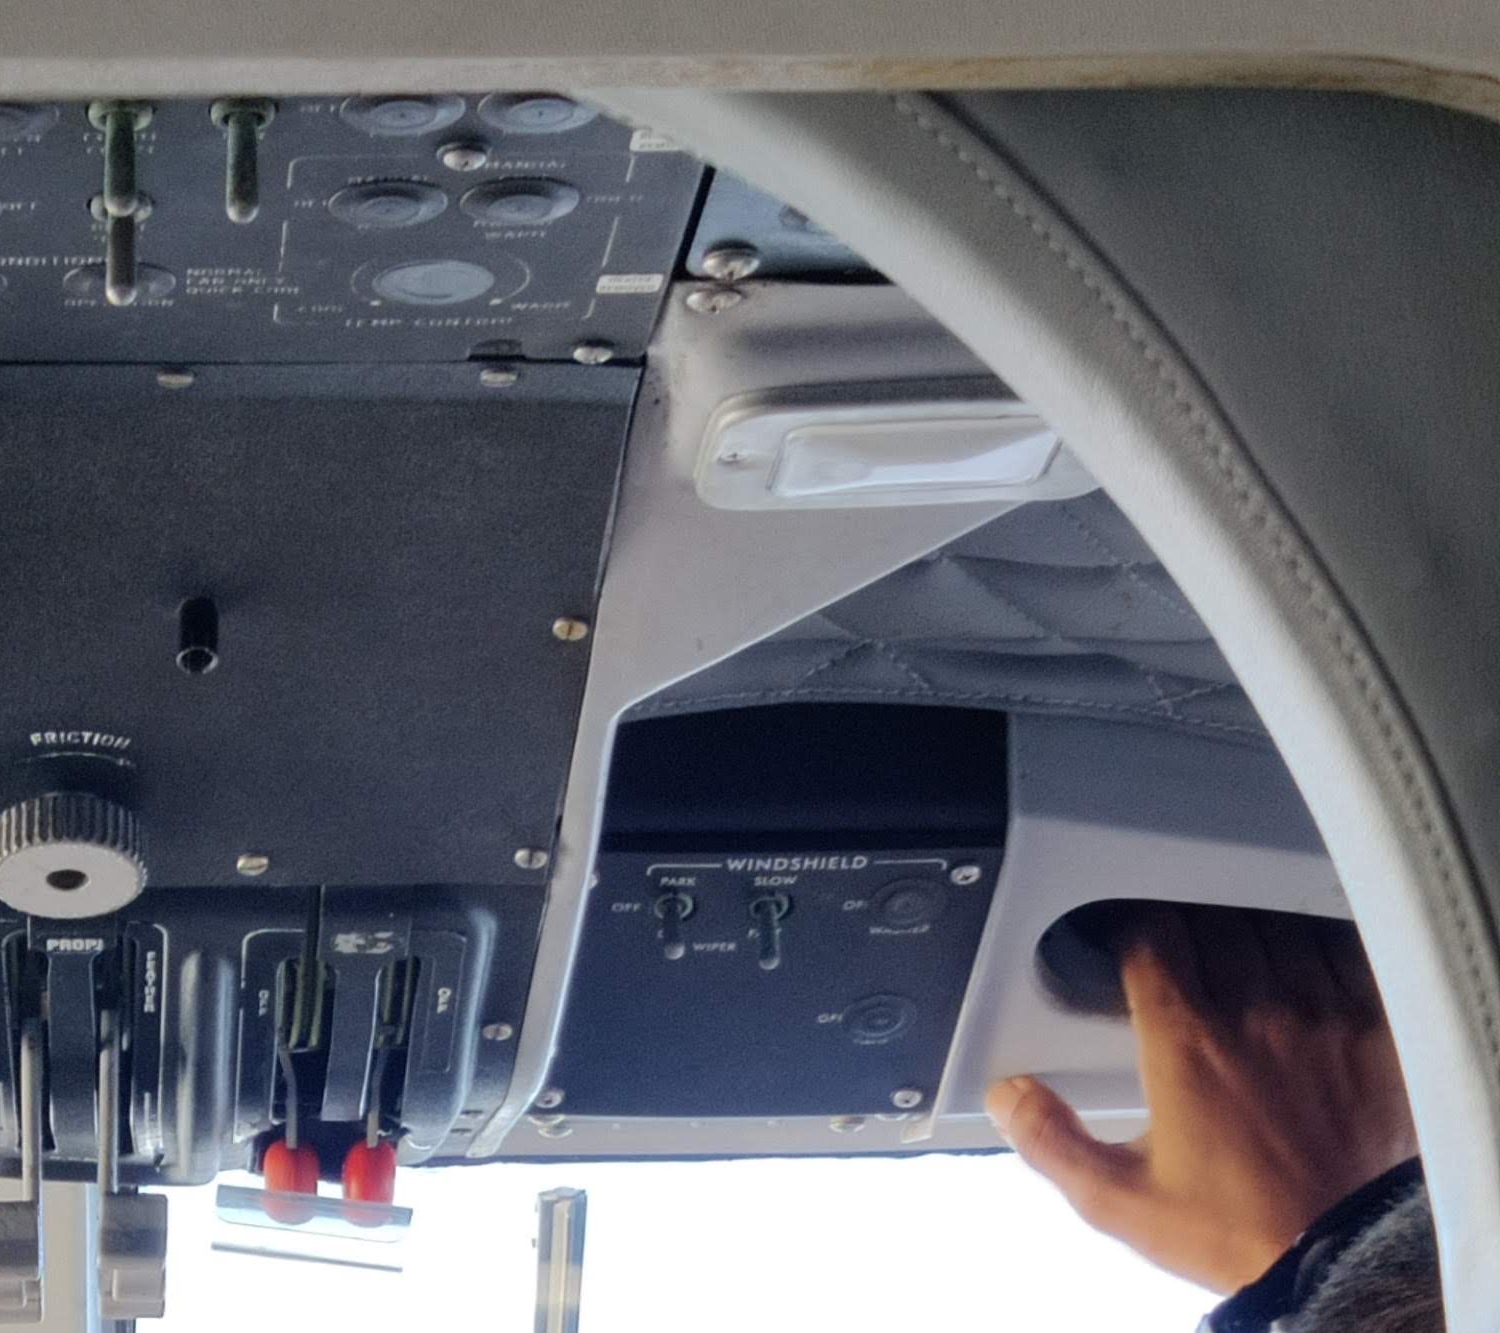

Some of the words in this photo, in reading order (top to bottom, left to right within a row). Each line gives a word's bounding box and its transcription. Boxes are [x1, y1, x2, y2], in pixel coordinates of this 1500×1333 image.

[29, 730, 133, 751] FRICTION
[724, 855, 869, 872] WINDSHIELD
[659, 876, 697, 887] PARK
[753, 875, 798, 887] SLOW
[692, 942, 737, 953] WIPER
